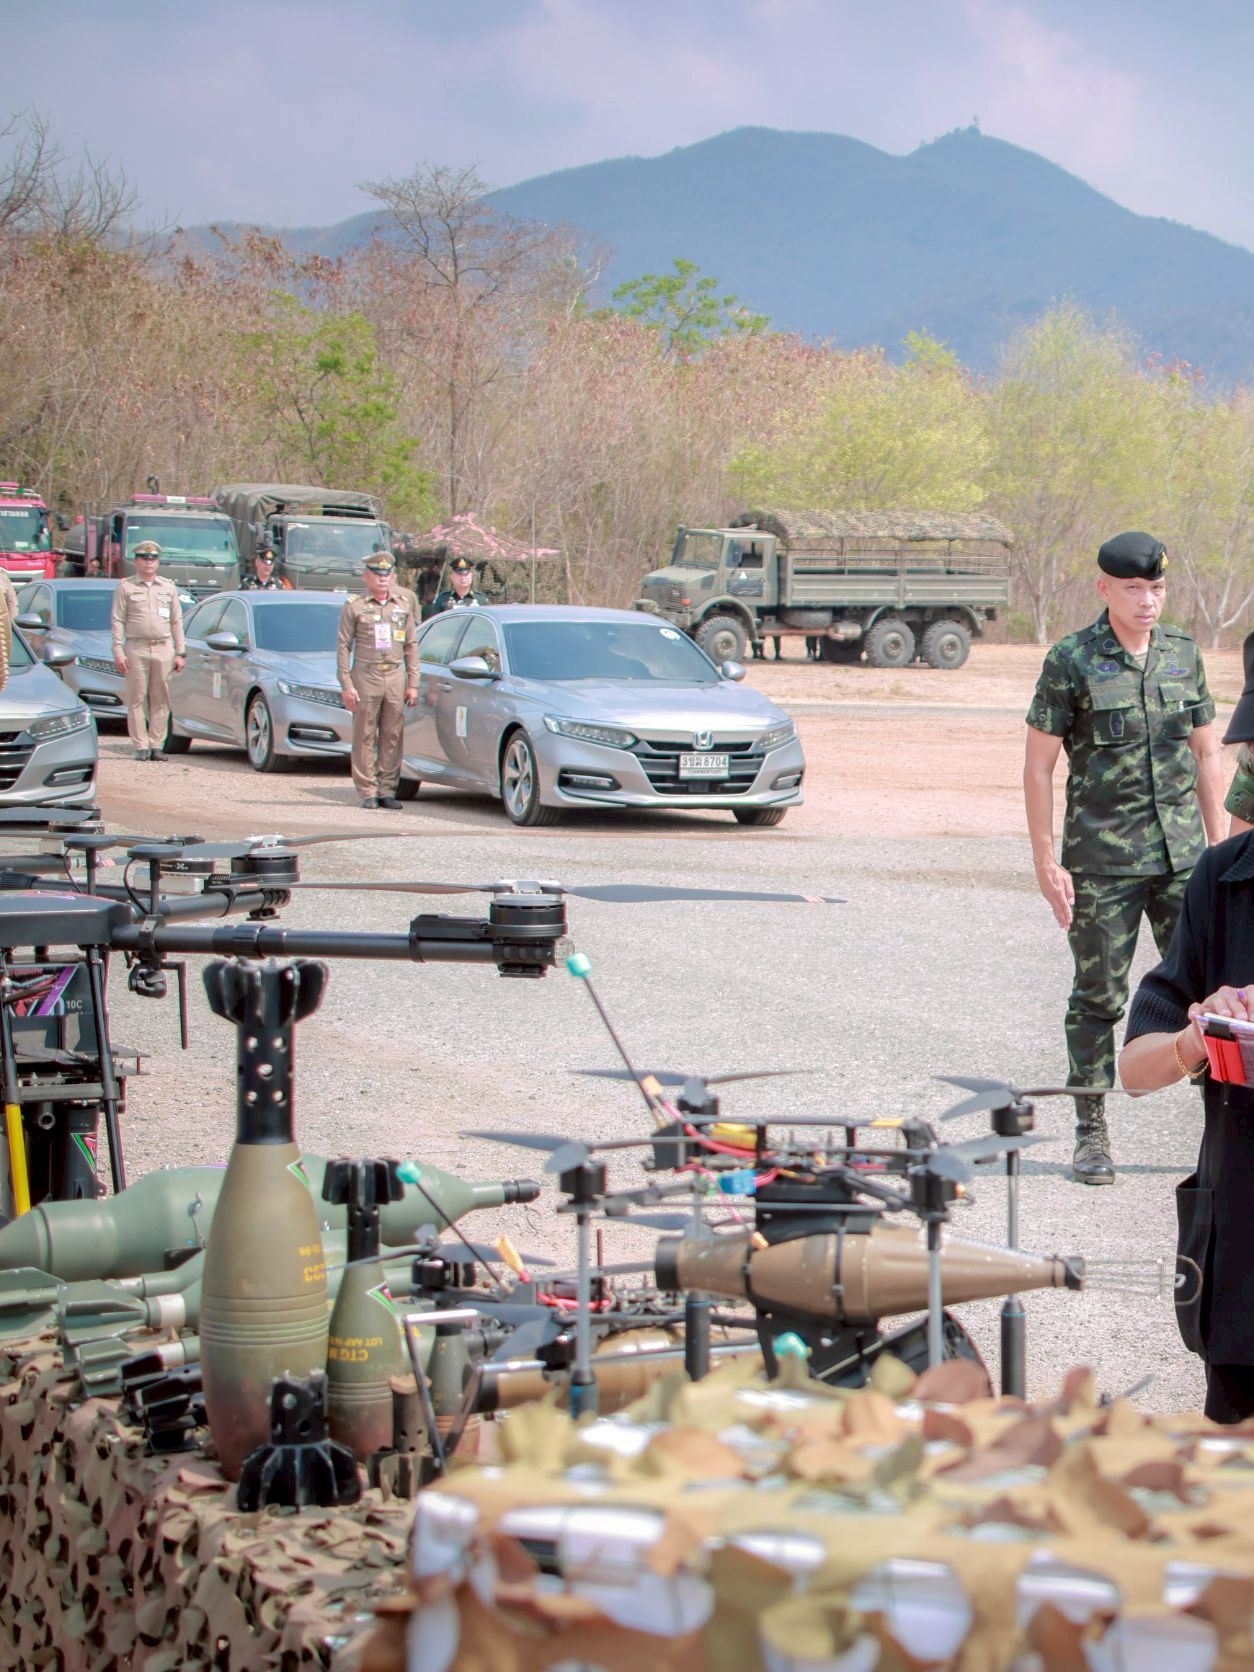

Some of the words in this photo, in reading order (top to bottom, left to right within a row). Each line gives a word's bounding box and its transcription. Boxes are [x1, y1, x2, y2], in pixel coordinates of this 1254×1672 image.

[704, 756, 727, 766] 8704
[66, 1000, 83, 1009] 10C
[340, 1348, 369, 1361] CTG
